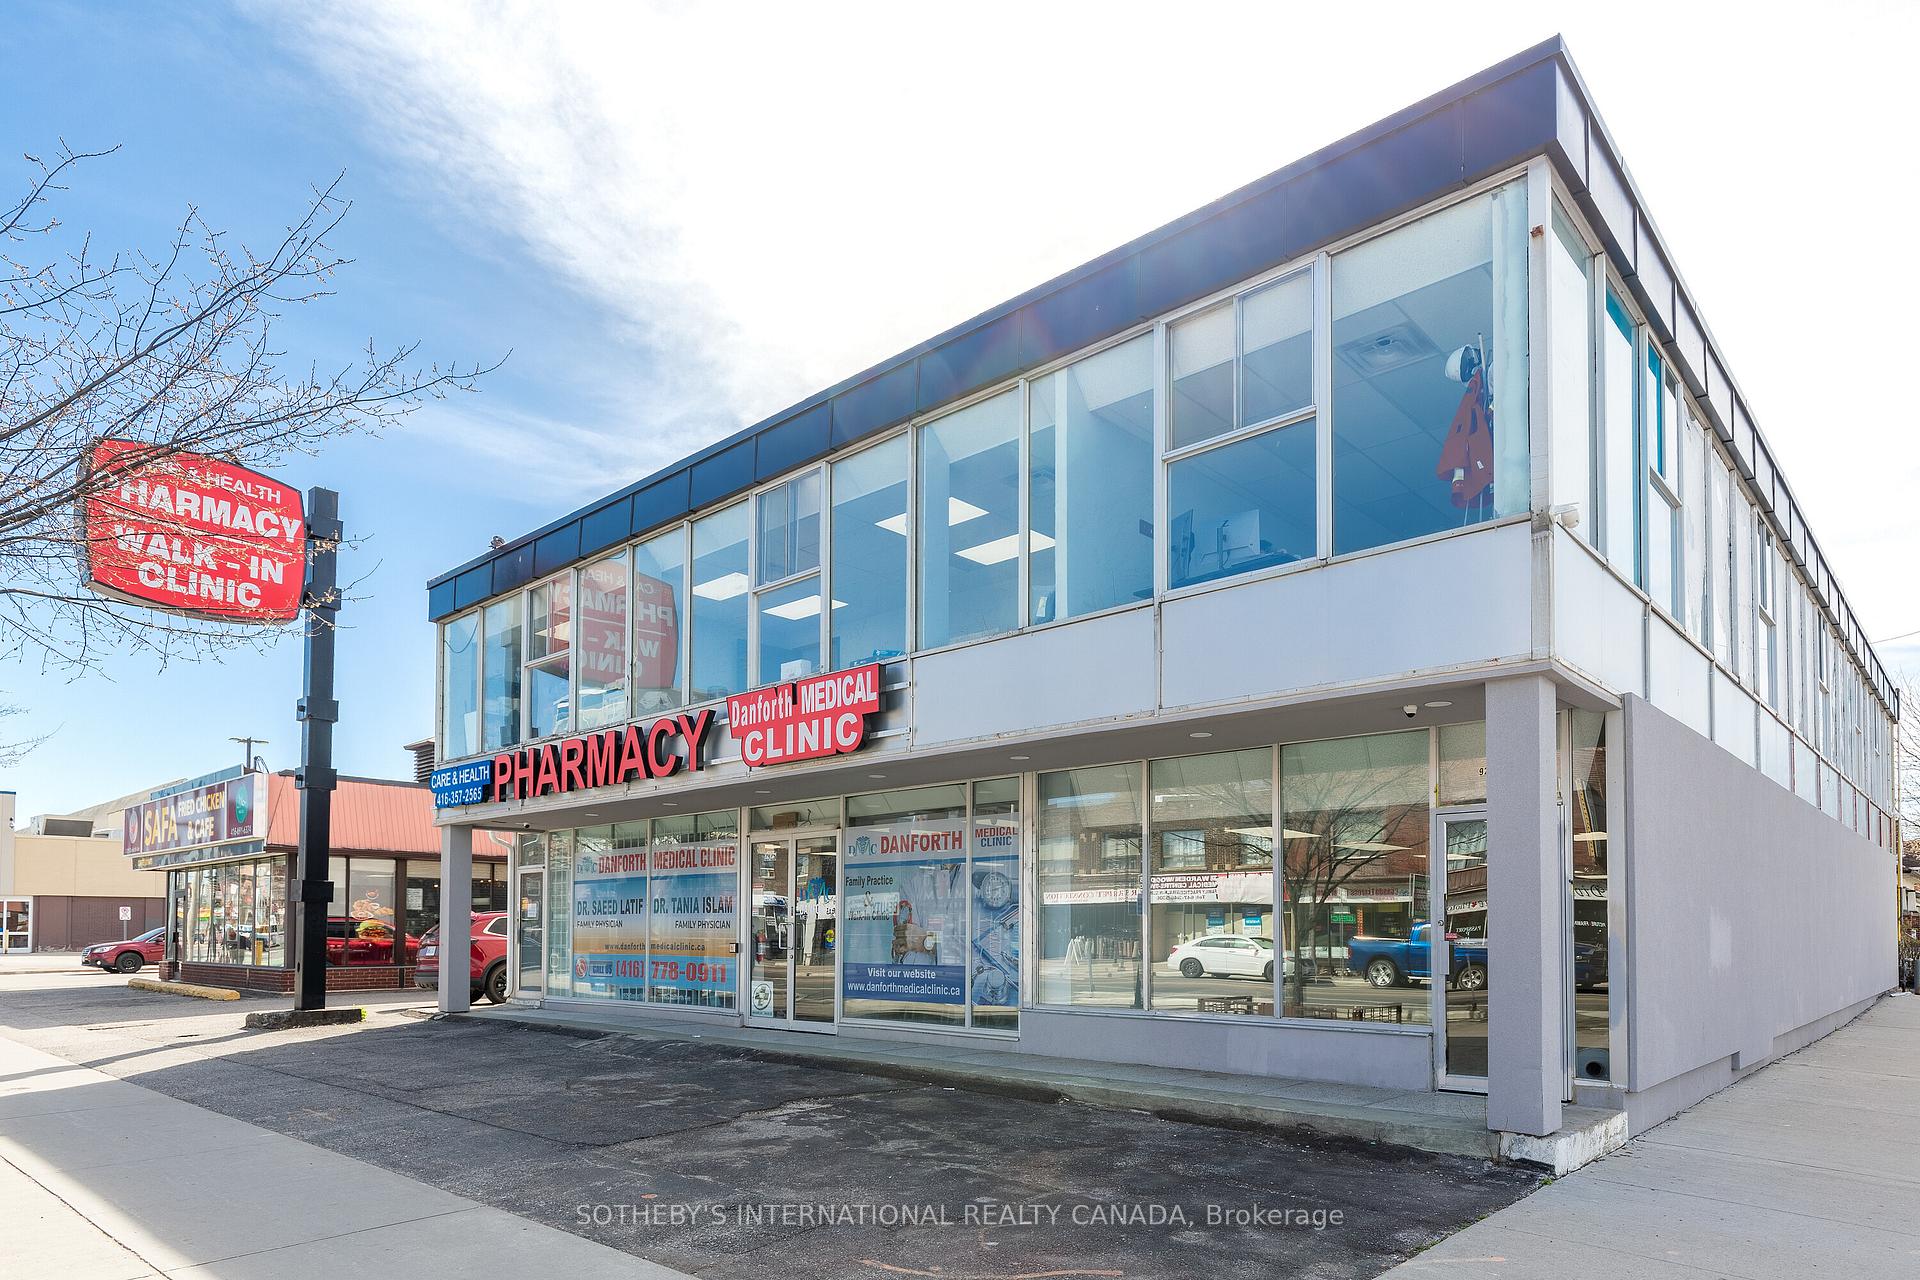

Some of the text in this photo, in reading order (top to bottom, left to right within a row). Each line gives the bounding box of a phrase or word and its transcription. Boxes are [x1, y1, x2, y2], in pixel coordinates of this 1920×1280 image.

[206, 471, 281, 504] HEALTH
[138, 561, 262, 608] CLINIC
[731, 670, 877, 729] Danforth MEDICAL
[744, 712, 858, 762] CLINIC
[493, 708, 712, 803] PHARMACY
[431, 765, 490, 789] CARE & HEALTH
[177, 798, 196, 818] FRIED
[195, 790, 226, 814] CHICKEN
[436, 786, 482, 805] 416-357-2565
[144, 804, 178, 847] SAFA
[186, 816, 215, 840] & CAFE
[975, 826, 1019, 838] MEDICAL
[880, 830, 963, 854] DANFORTH
[980, 835, 1013, 848] CLINIC
[598, 852, 647, 874] DANFORTH
[653, 848, 698, 870] MEDICAL
[700, 845, 735, 868] CLINIC
[845, 875, 894, 888] Family Practice
[577, 898, 644, 916] DR. SAEED LATIF
[653, 895, 733, 914] DR. TANIA ISLAM
[864, 890, 874, 907] &
[577, 919, 623, 929] FAMILY PHYSICIAN
[674, 919, 731, 929] FAMILY PHYSICIAN
[871, 909, 890, 921] Clinic
[651, 960, 727, 984] 778-0911
[867, 967, 937, 979] Visit our website
[847, 981, 961, 996] www.danforthmedicalclinic.ca
